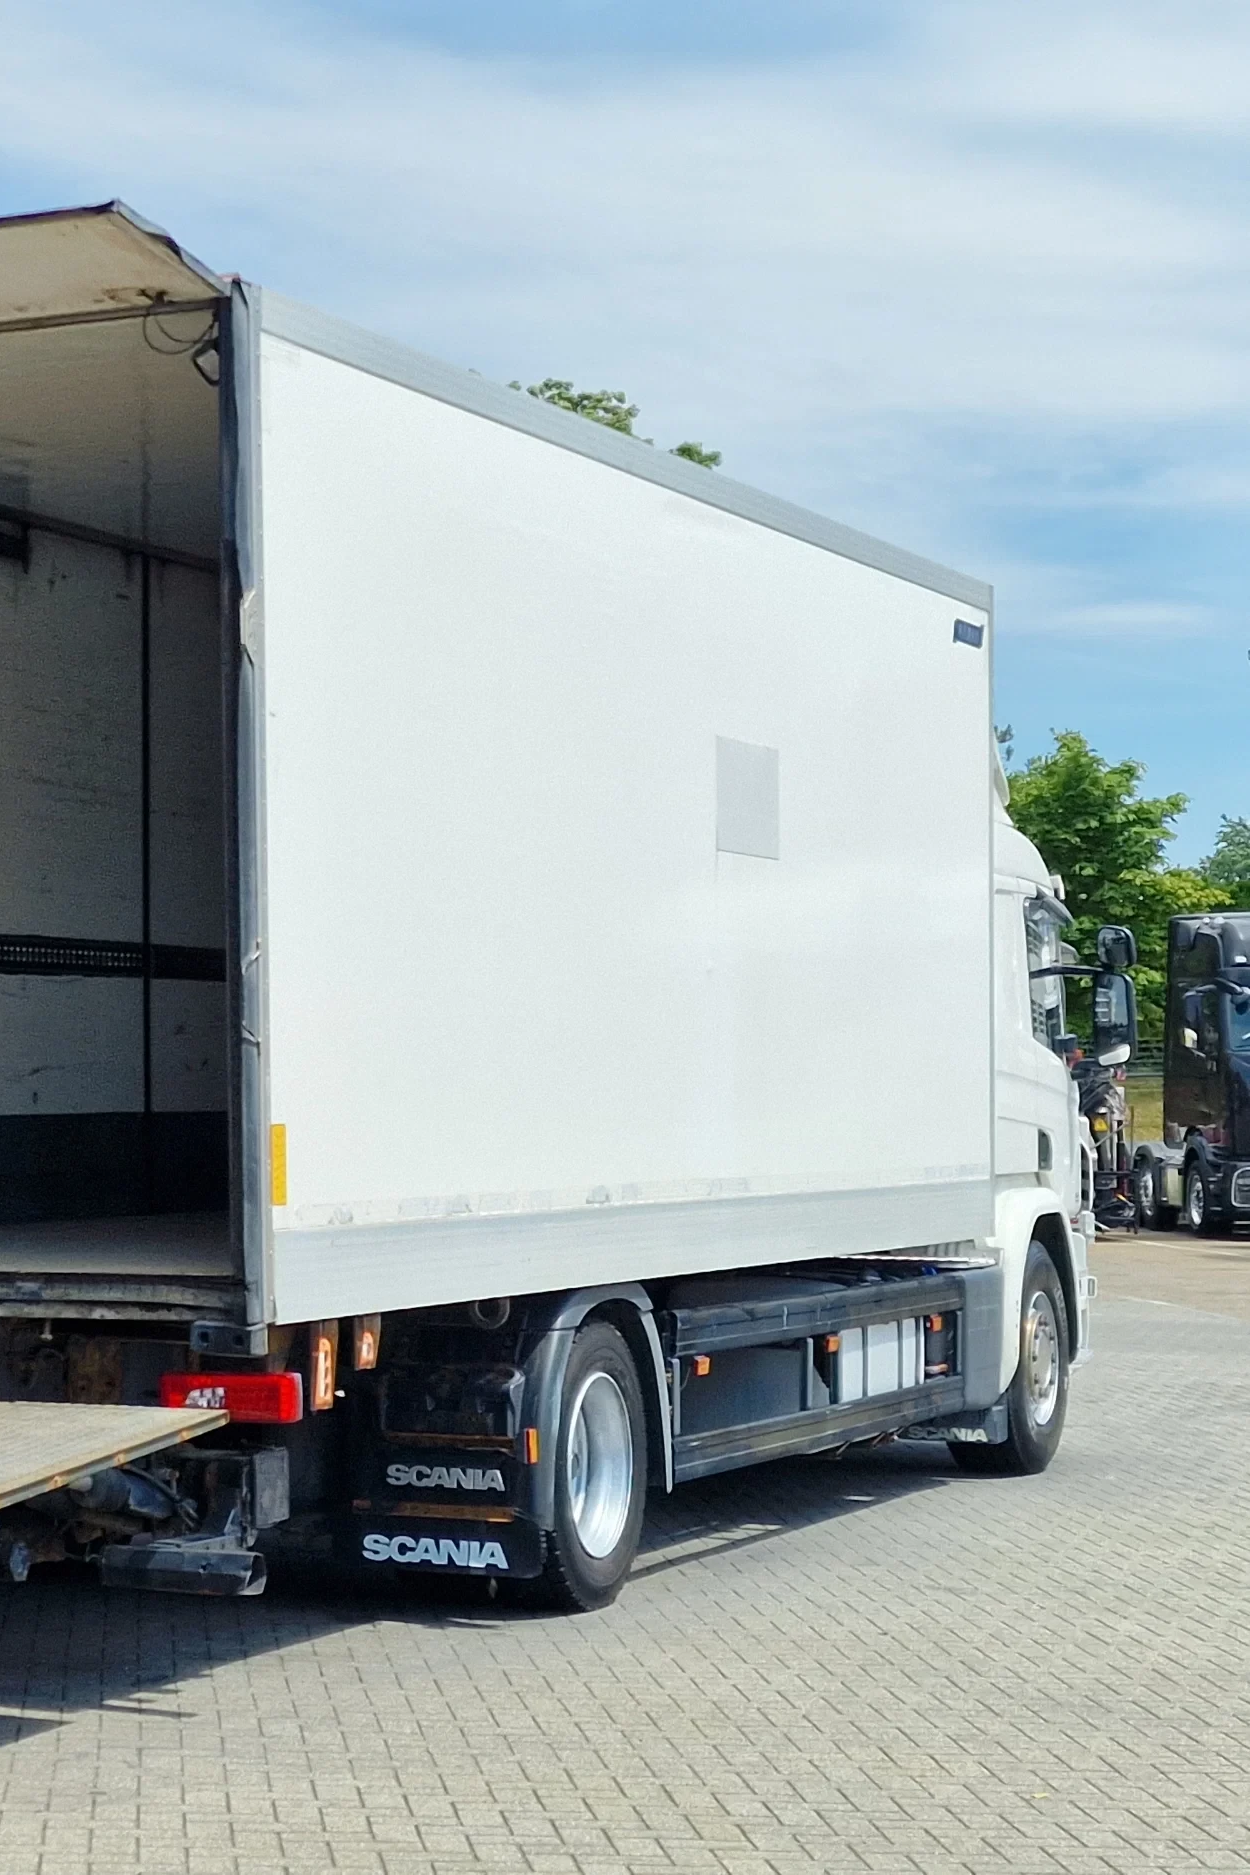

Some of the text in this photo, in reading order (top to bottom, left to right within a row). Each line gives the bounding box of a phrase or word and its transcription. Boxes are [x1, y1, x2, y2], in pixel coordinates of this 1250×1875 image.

[908, 1427, 988, 1442] SCANIA
[386, 1464, 505, 1491] SCANIA
[362, 1534, 509, 1569] SCANIA
